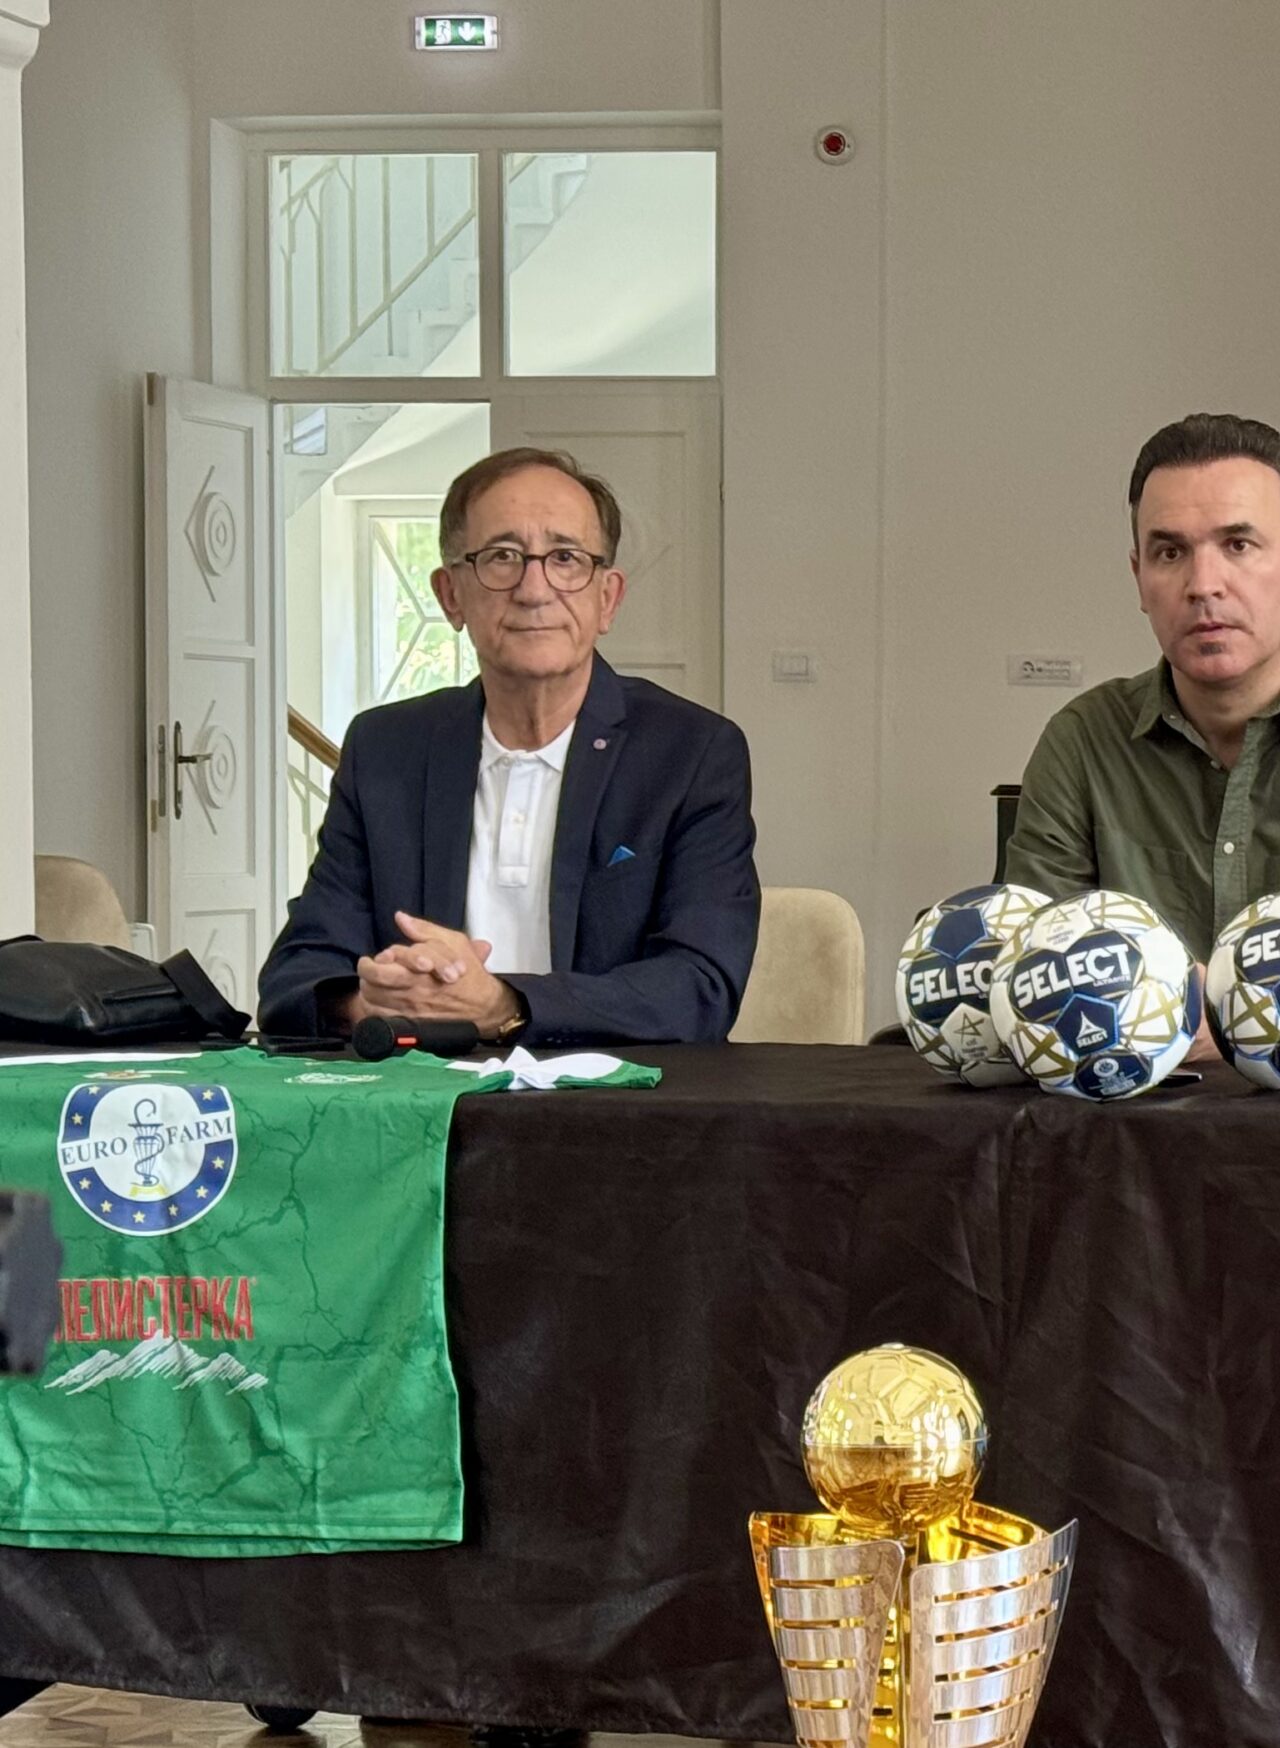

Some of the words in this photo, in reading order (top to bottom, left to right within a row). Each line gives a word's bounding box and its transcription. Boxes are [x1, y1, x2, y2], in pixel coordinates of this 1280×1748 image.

[909, 959, 994, 1006] SELEC
[1013, 943, 1131, 1009] SELECT
[1076, 1028, 1108, 1048] SELECT
[61, 1136, 128, 1167] EURO
[167, 1115, 233, 1146] FARM
